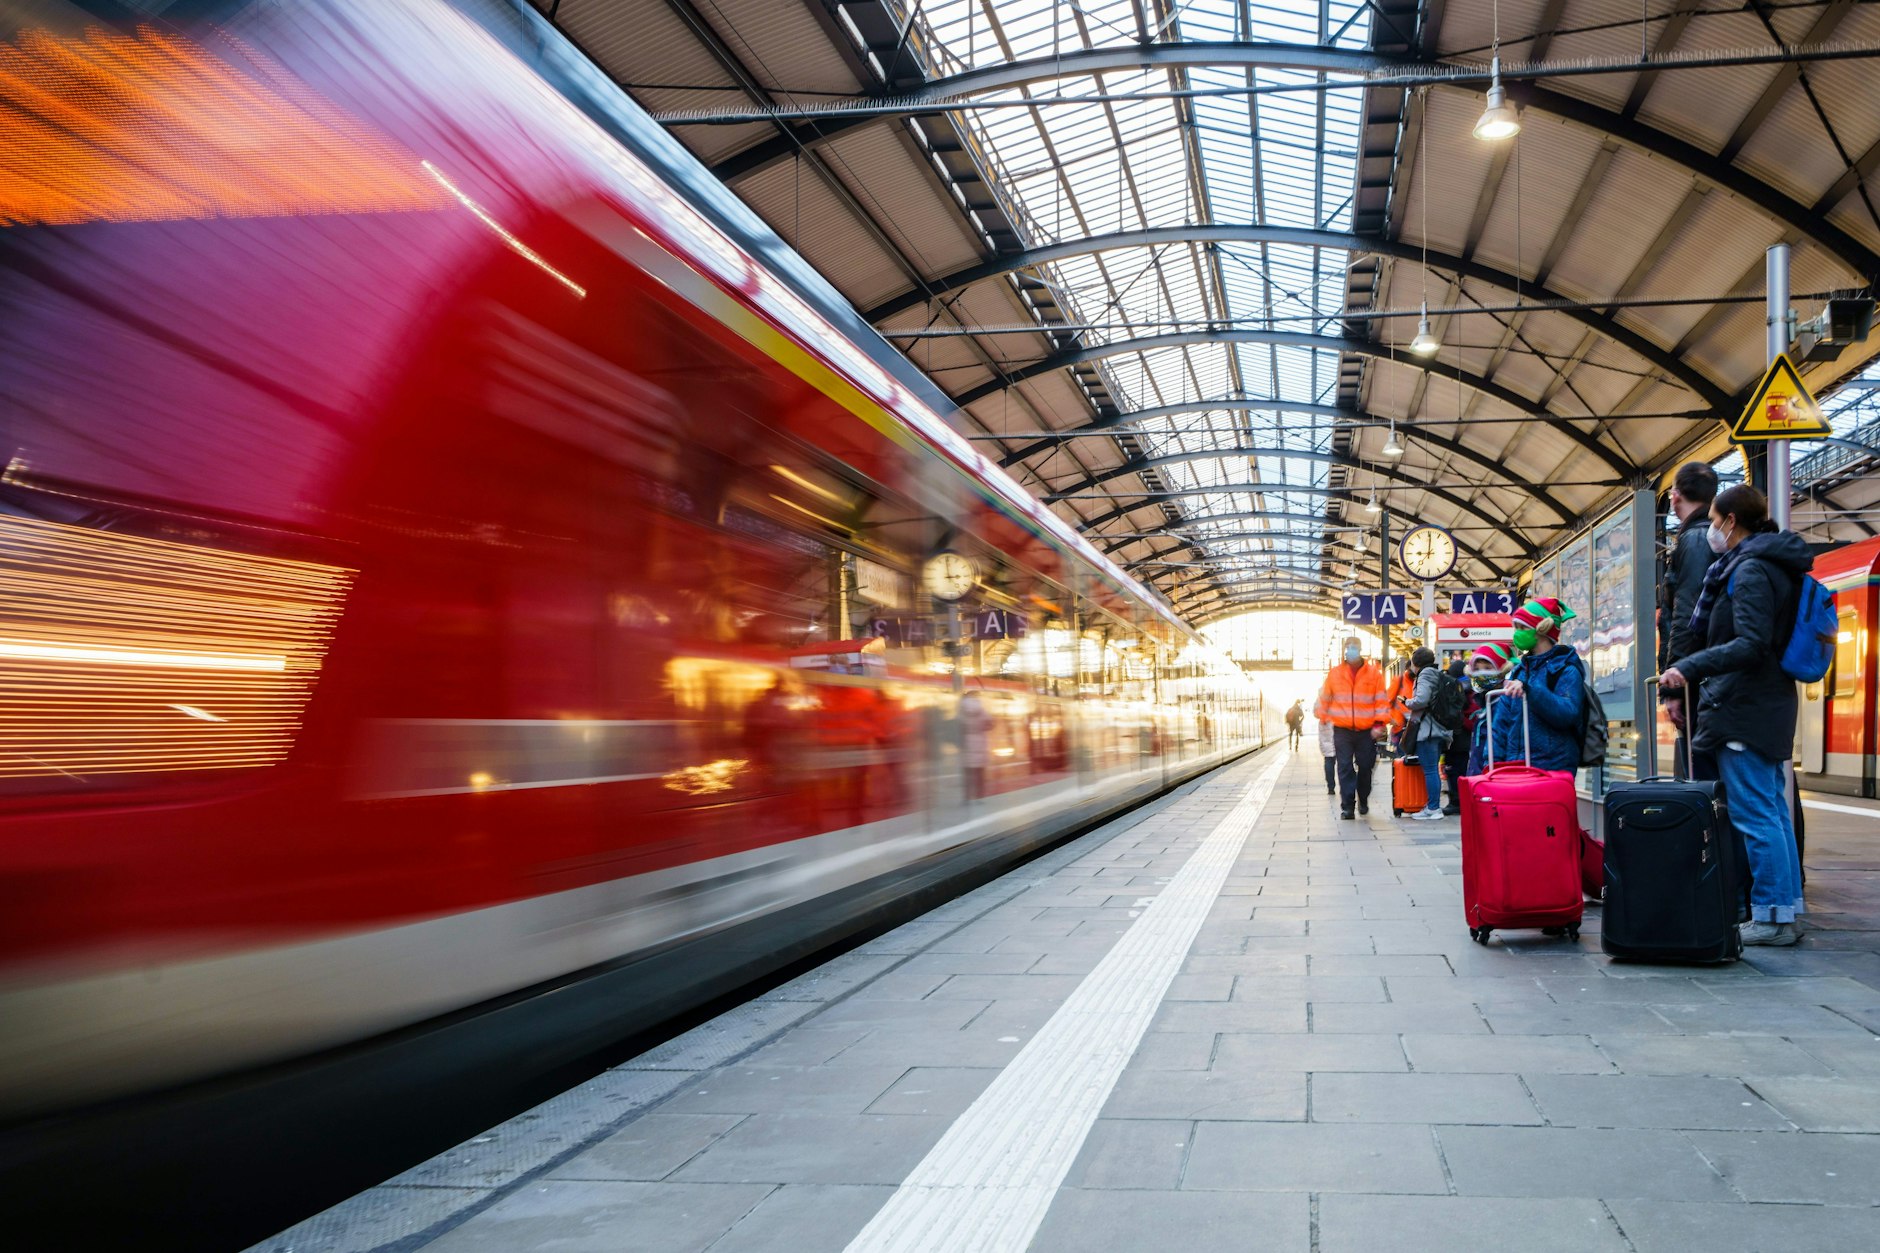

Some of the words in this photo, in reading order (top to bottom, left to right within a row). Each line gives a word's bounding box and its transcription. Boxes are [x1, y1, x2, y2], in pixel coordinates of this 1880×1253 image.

[1346, 597, 1361, 619] 2
[1379, 596, 1398, 618] A
[1461, 594, 1478, 614] A
[1497, 594, 1513, 615] 3
